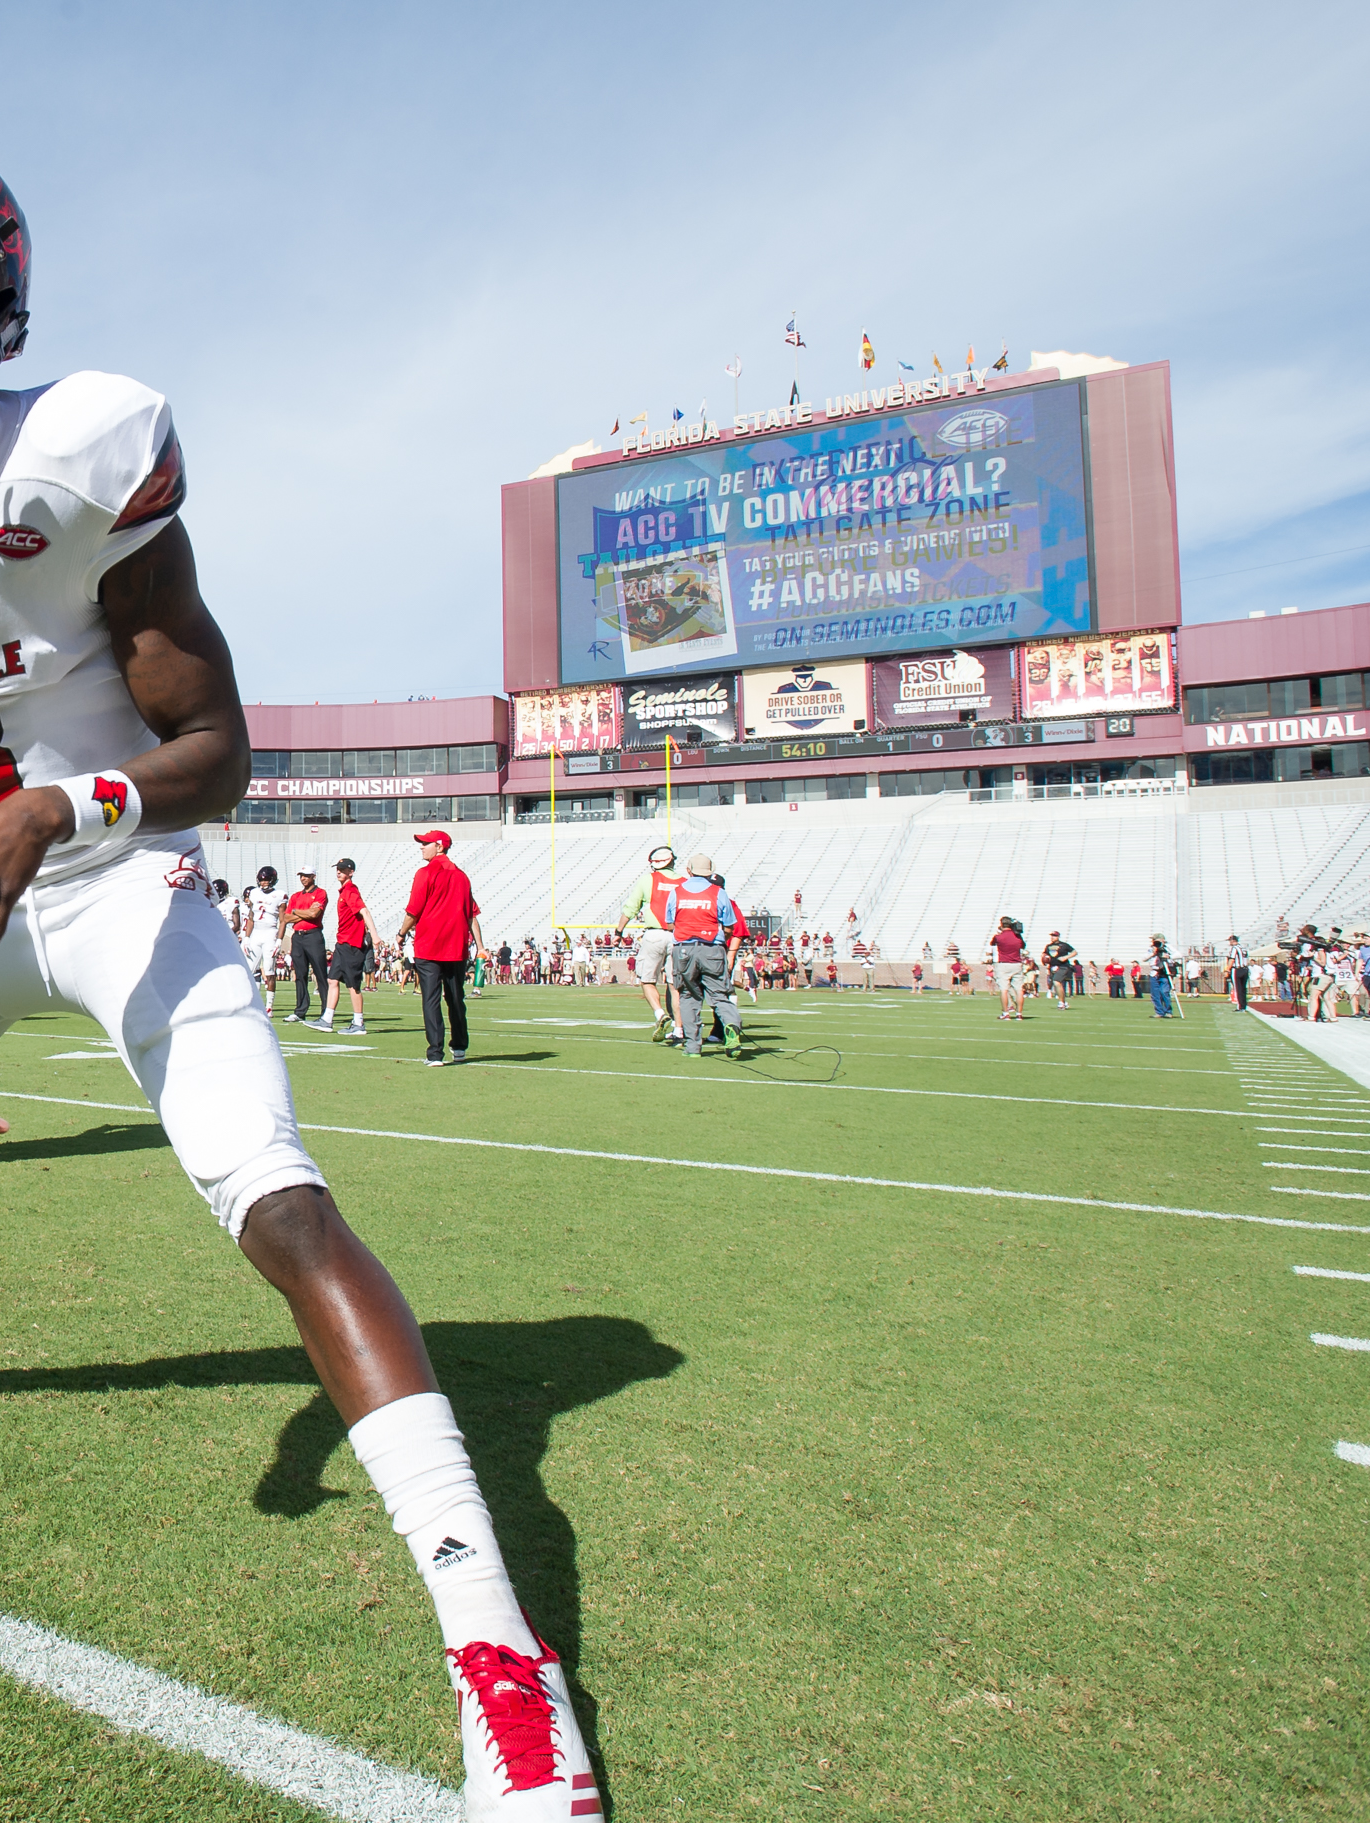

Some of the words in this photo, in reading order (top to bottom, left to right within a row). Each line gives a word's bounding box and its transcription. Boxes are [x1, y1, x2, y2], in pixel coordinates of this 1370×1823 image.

[622, 421, 720, 456] FLORIDA
[733, 402, 812, 435] STATE
[826, 367, 989, 418] UNIVERSITY
[951, 416, 999, 434] ACC
[614, 483, 676, 513] WANT
[684, 477, 710, 499] TO
[718, 471, 745, 496] BE
[753, 466, 776, 491] IN
[786, 456, 829, 484] THE
[837, 443, 902, 477] NEXT
[616, 510, 676, 549] ACC
[687, 501, 729, 537] TV
[743, 457, 1007, 529] COMMERCIAL?
[765, 506, 912, 552] TAILGATE
[925, 491, 1011, 530] ZONE
[578, 533, 727, 577] TAILGATE
[743, 556, 771, 573] TAG
[775, 550, 814, 568] YOUR
[900, 529, 960, 551] VIDEOS
[774, 626, 804, 647] ON
[812, 601, 1016, 644] SEMINOLES.COM
[1026, 637, 1064, 647] RETIRED
[1068, 628, 1160, 643] NUMBERS/JERSEYS
[901, 660, 957, 685] FSU
[520, 690, 547, 698] RETIRED
[550, 683, 612, 695] NUMBERS/JERSEYS
[628, 682, 728, 713] Seminole
[903, 683, 942, 698] Credit
[945, 680, 982, 695] Union
[768, 696, 795, 708] DRIVE
[797, 694, 828, 705] SOBER
[829, 693, 843, 703] OR
[635, 700, 729, 720] SPORTSHOP
[766, 708, 783, 719] GET
[785, 706, 819, 717] PULLED
[821, 704, 845, 715] OVER
[1108, 718, 1130, 733] 20
[1205, 714, 1366, 747] NATIONAL
[522, 743, 536, 755] 25
[560, 739, 573, 751] 50
[581, 738, 589, 749] 2
[599, 736, 610, 748] 17
[887, 742, 893, 751] 1
[932, 734, 943, 748] 0
[1024, 732, 1033, 743] 3
[673, 752, 682, 765] 0
[781, 742, 826, 758] 54:10
[607, 761, 613, 770] 3
[246, 780, 269, 796] CC
[277, 778, 424, 796] CHAMPIONSHIPS
[657, 882, 679, 891] ESP
[678, 899, 712, 910] ESPN
[434, 1548, 477, 1570] adidas
